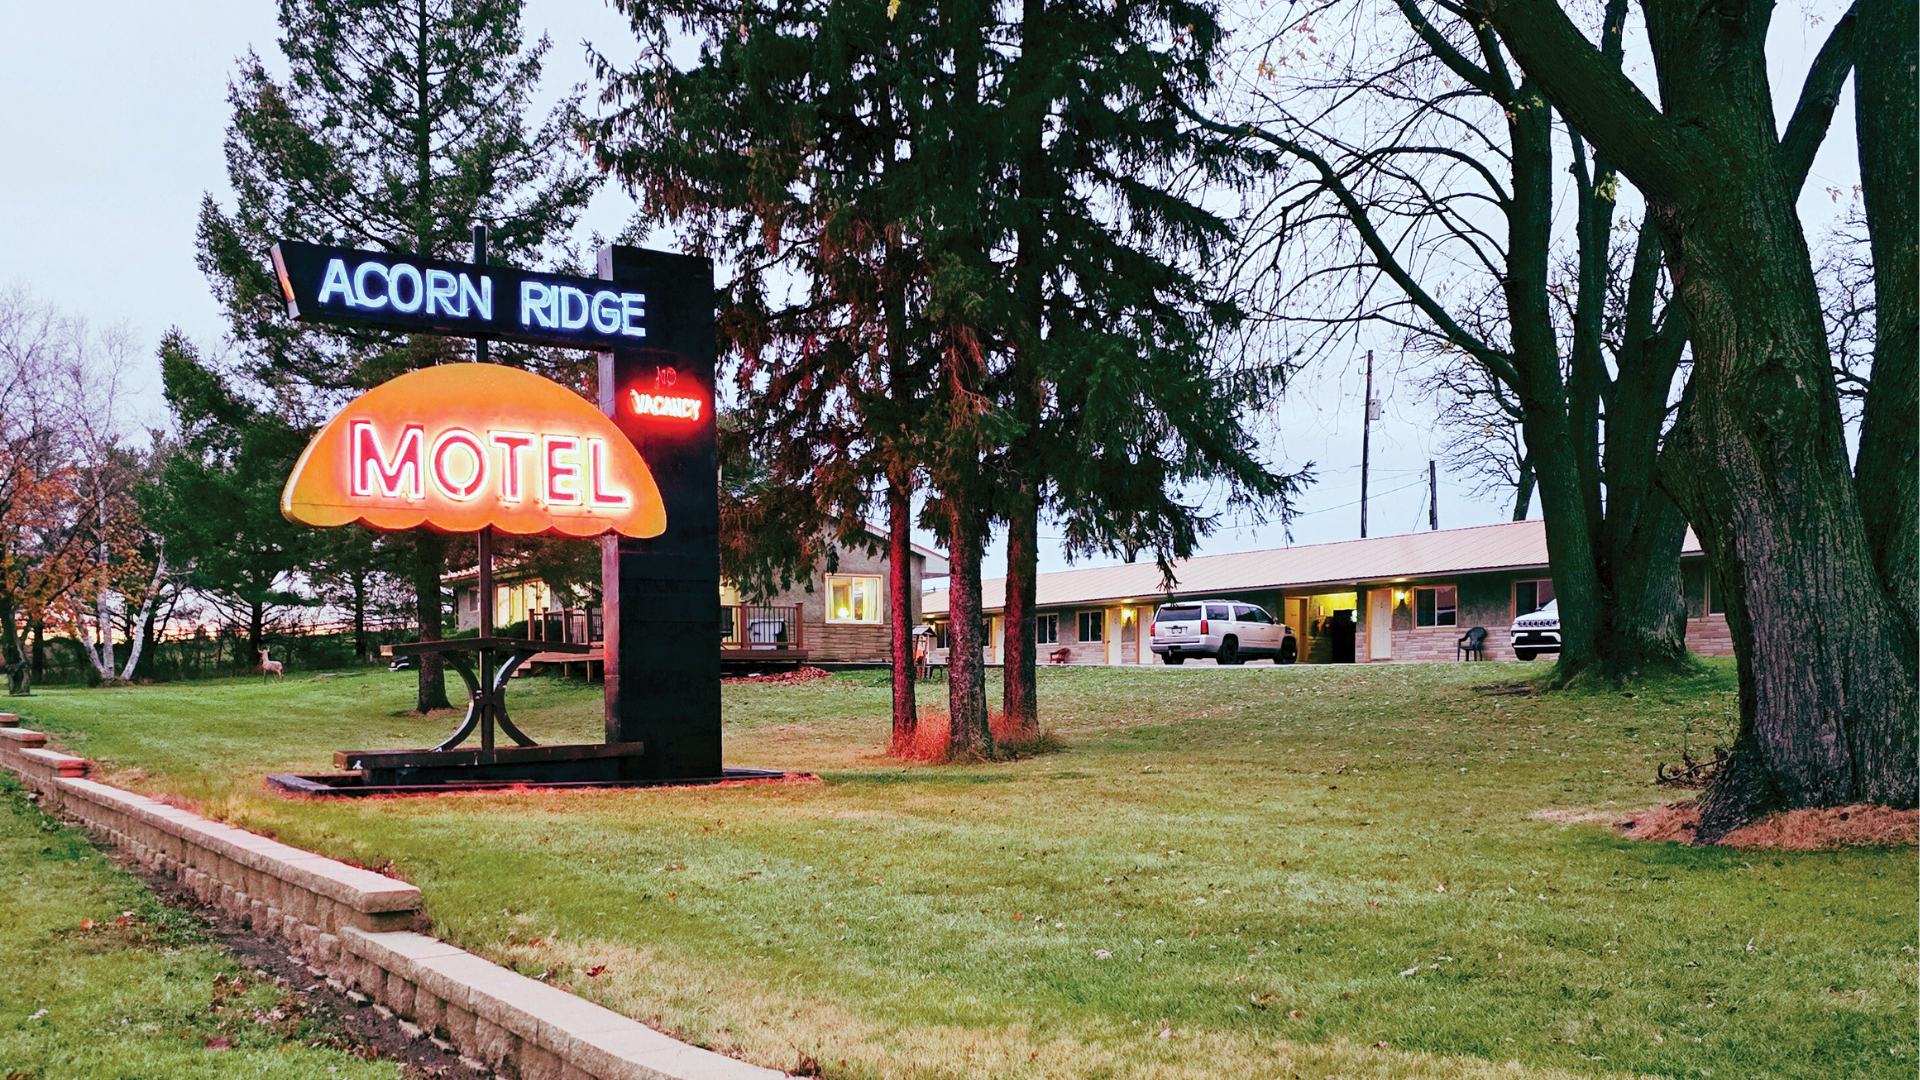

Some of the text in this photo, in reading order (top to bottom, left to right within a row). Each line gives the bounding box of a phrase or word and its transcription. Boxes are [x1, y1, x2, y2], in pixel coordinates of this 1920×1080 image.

[318, 258, 646, 337] ACORN RIDGE
[630, 389, 702, 421] VACANCY
[654, 366, 677, 390] NO
[350, 420, 631, 508] MOTEL
